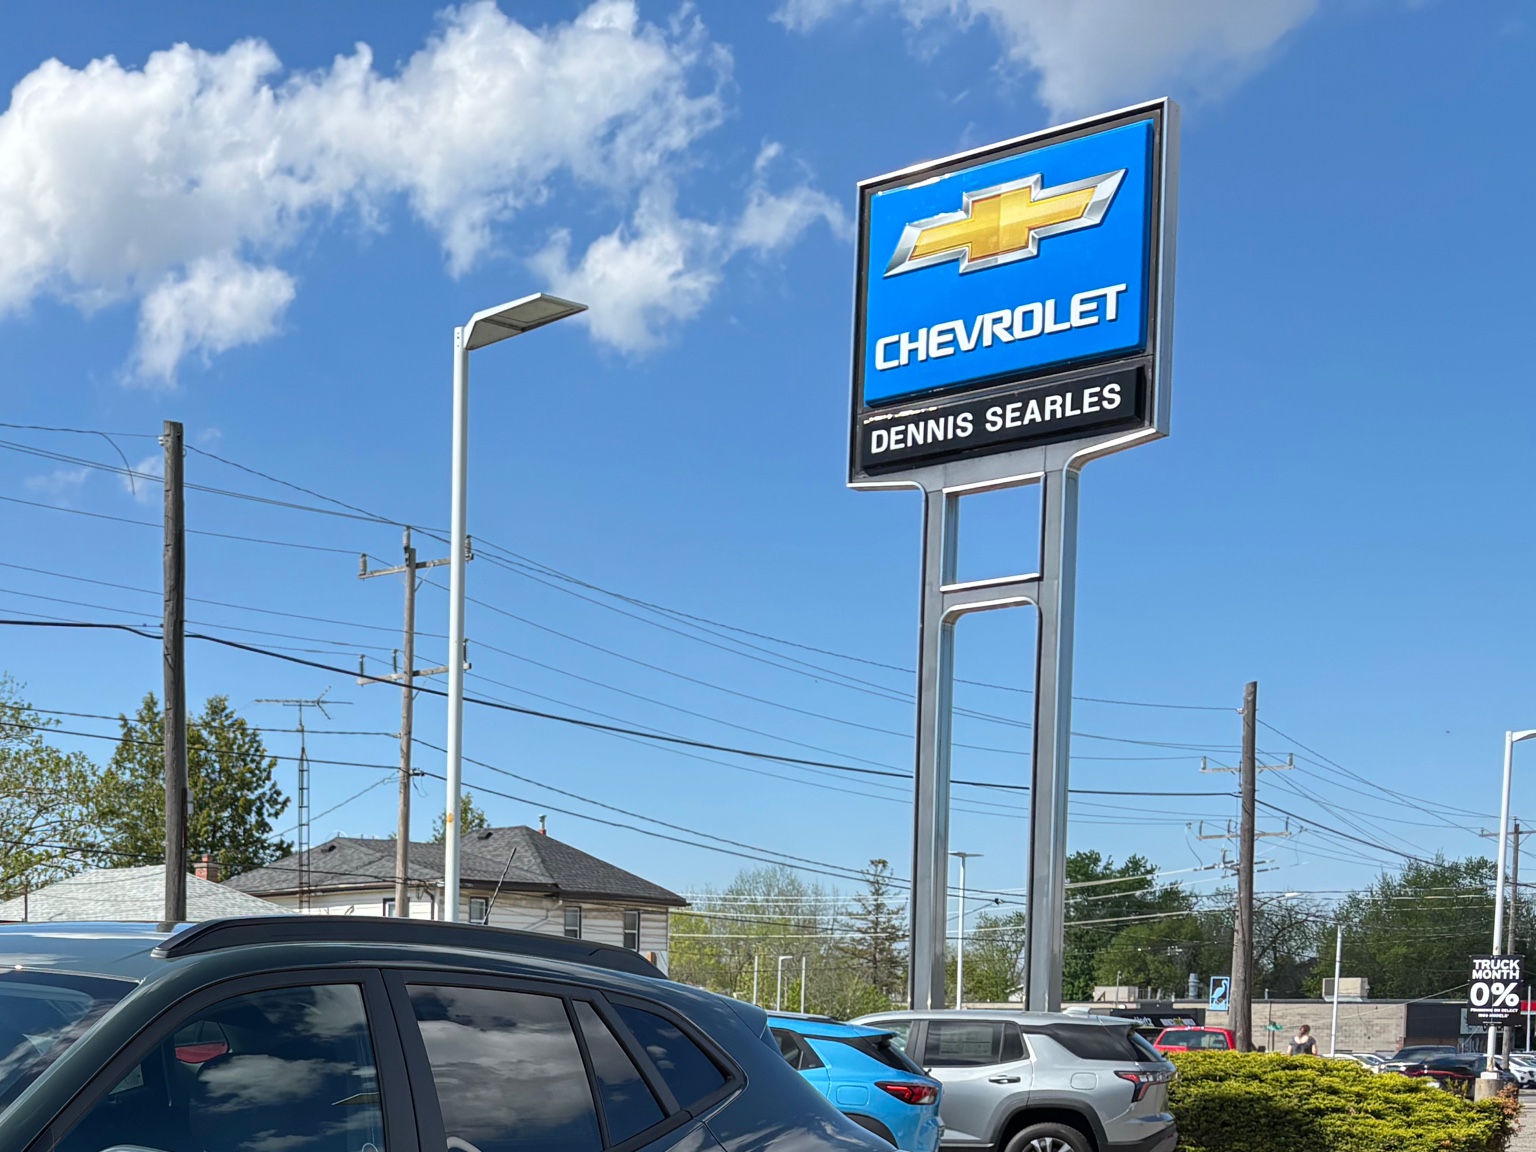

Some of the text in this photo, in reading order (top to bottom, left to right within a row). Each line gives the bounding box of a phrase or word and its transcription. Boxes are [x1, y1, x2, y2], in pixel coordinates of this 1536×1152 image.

[875, 283, 1127, 371] CHEVROLET
[870, 383, 1122, 454] DENNIS SEARLES
[1472, 969, 1520, 980] MONTH
[1473, 959, 1520, 970] TRUCK
[1470, 982, 1519, 1007] 0%
